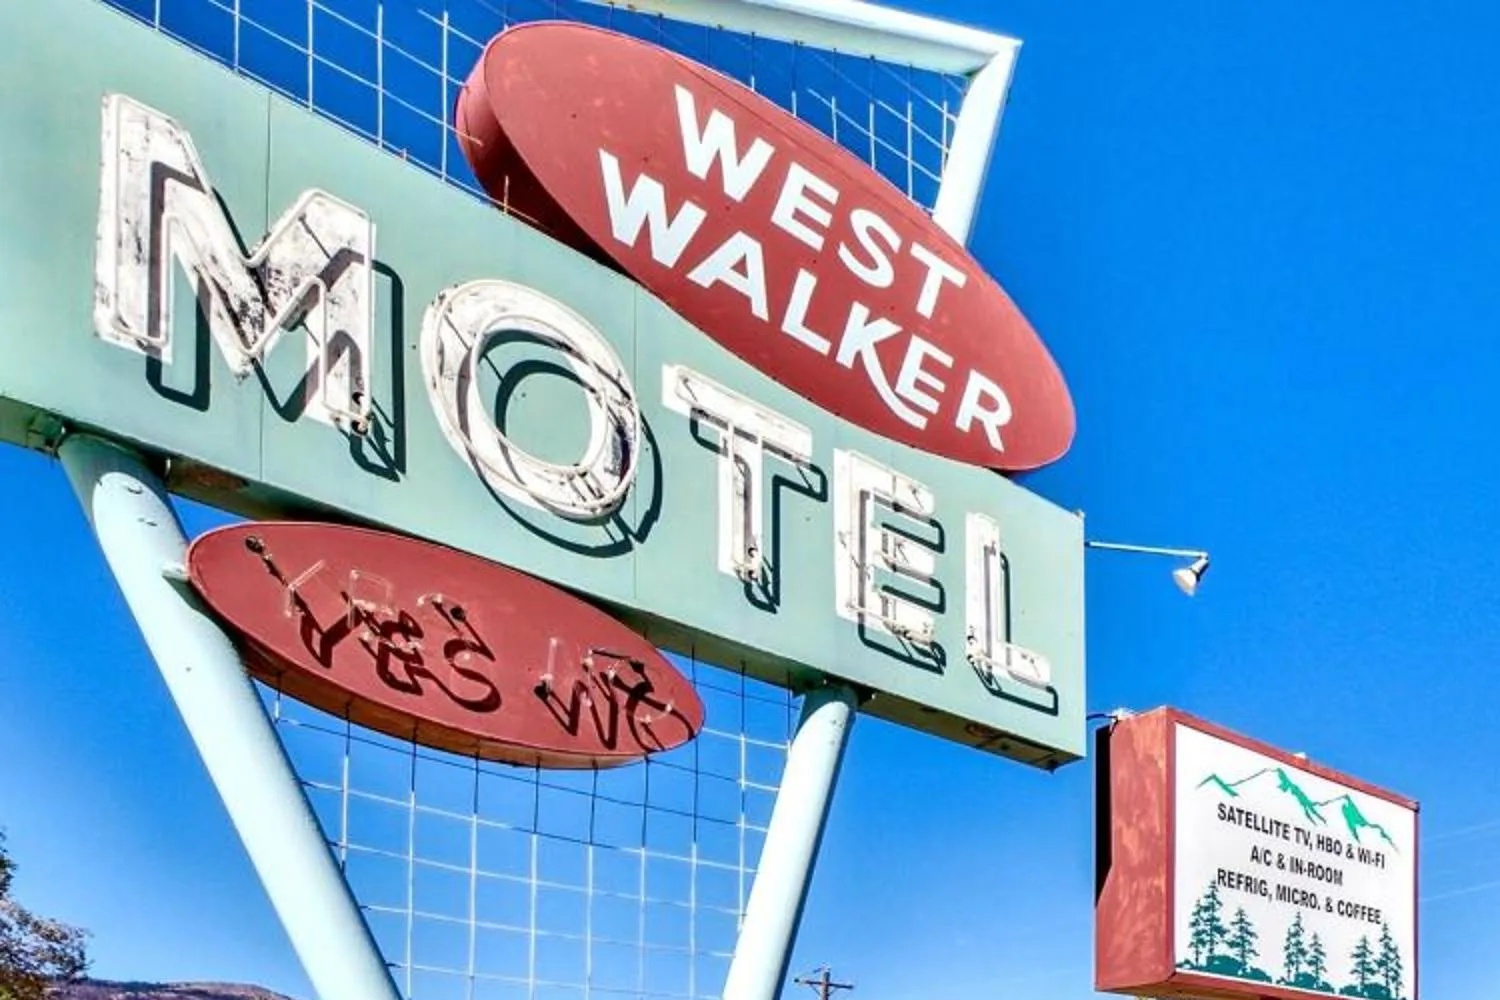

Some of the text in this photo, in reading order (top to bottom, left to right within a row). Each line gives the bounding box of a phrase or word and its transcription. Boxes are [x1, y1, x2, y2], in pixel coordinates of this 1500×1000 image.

[675, 83, 967, 320] WEST
[599, 147, 1013, 454] WALKER
[94, 93, 1052, 690] MOTEL
[1217, 802, 1386, 870] SATELLITE TV, HBO & WI-FI
[1217, 868, 1273, 902] REFRIG,
[1325, 897, 1334, 914] &
[1337, 899, 1382, 925] COFFEE
[1251, 845, 1344, 886] A/C & IN-ROOM
